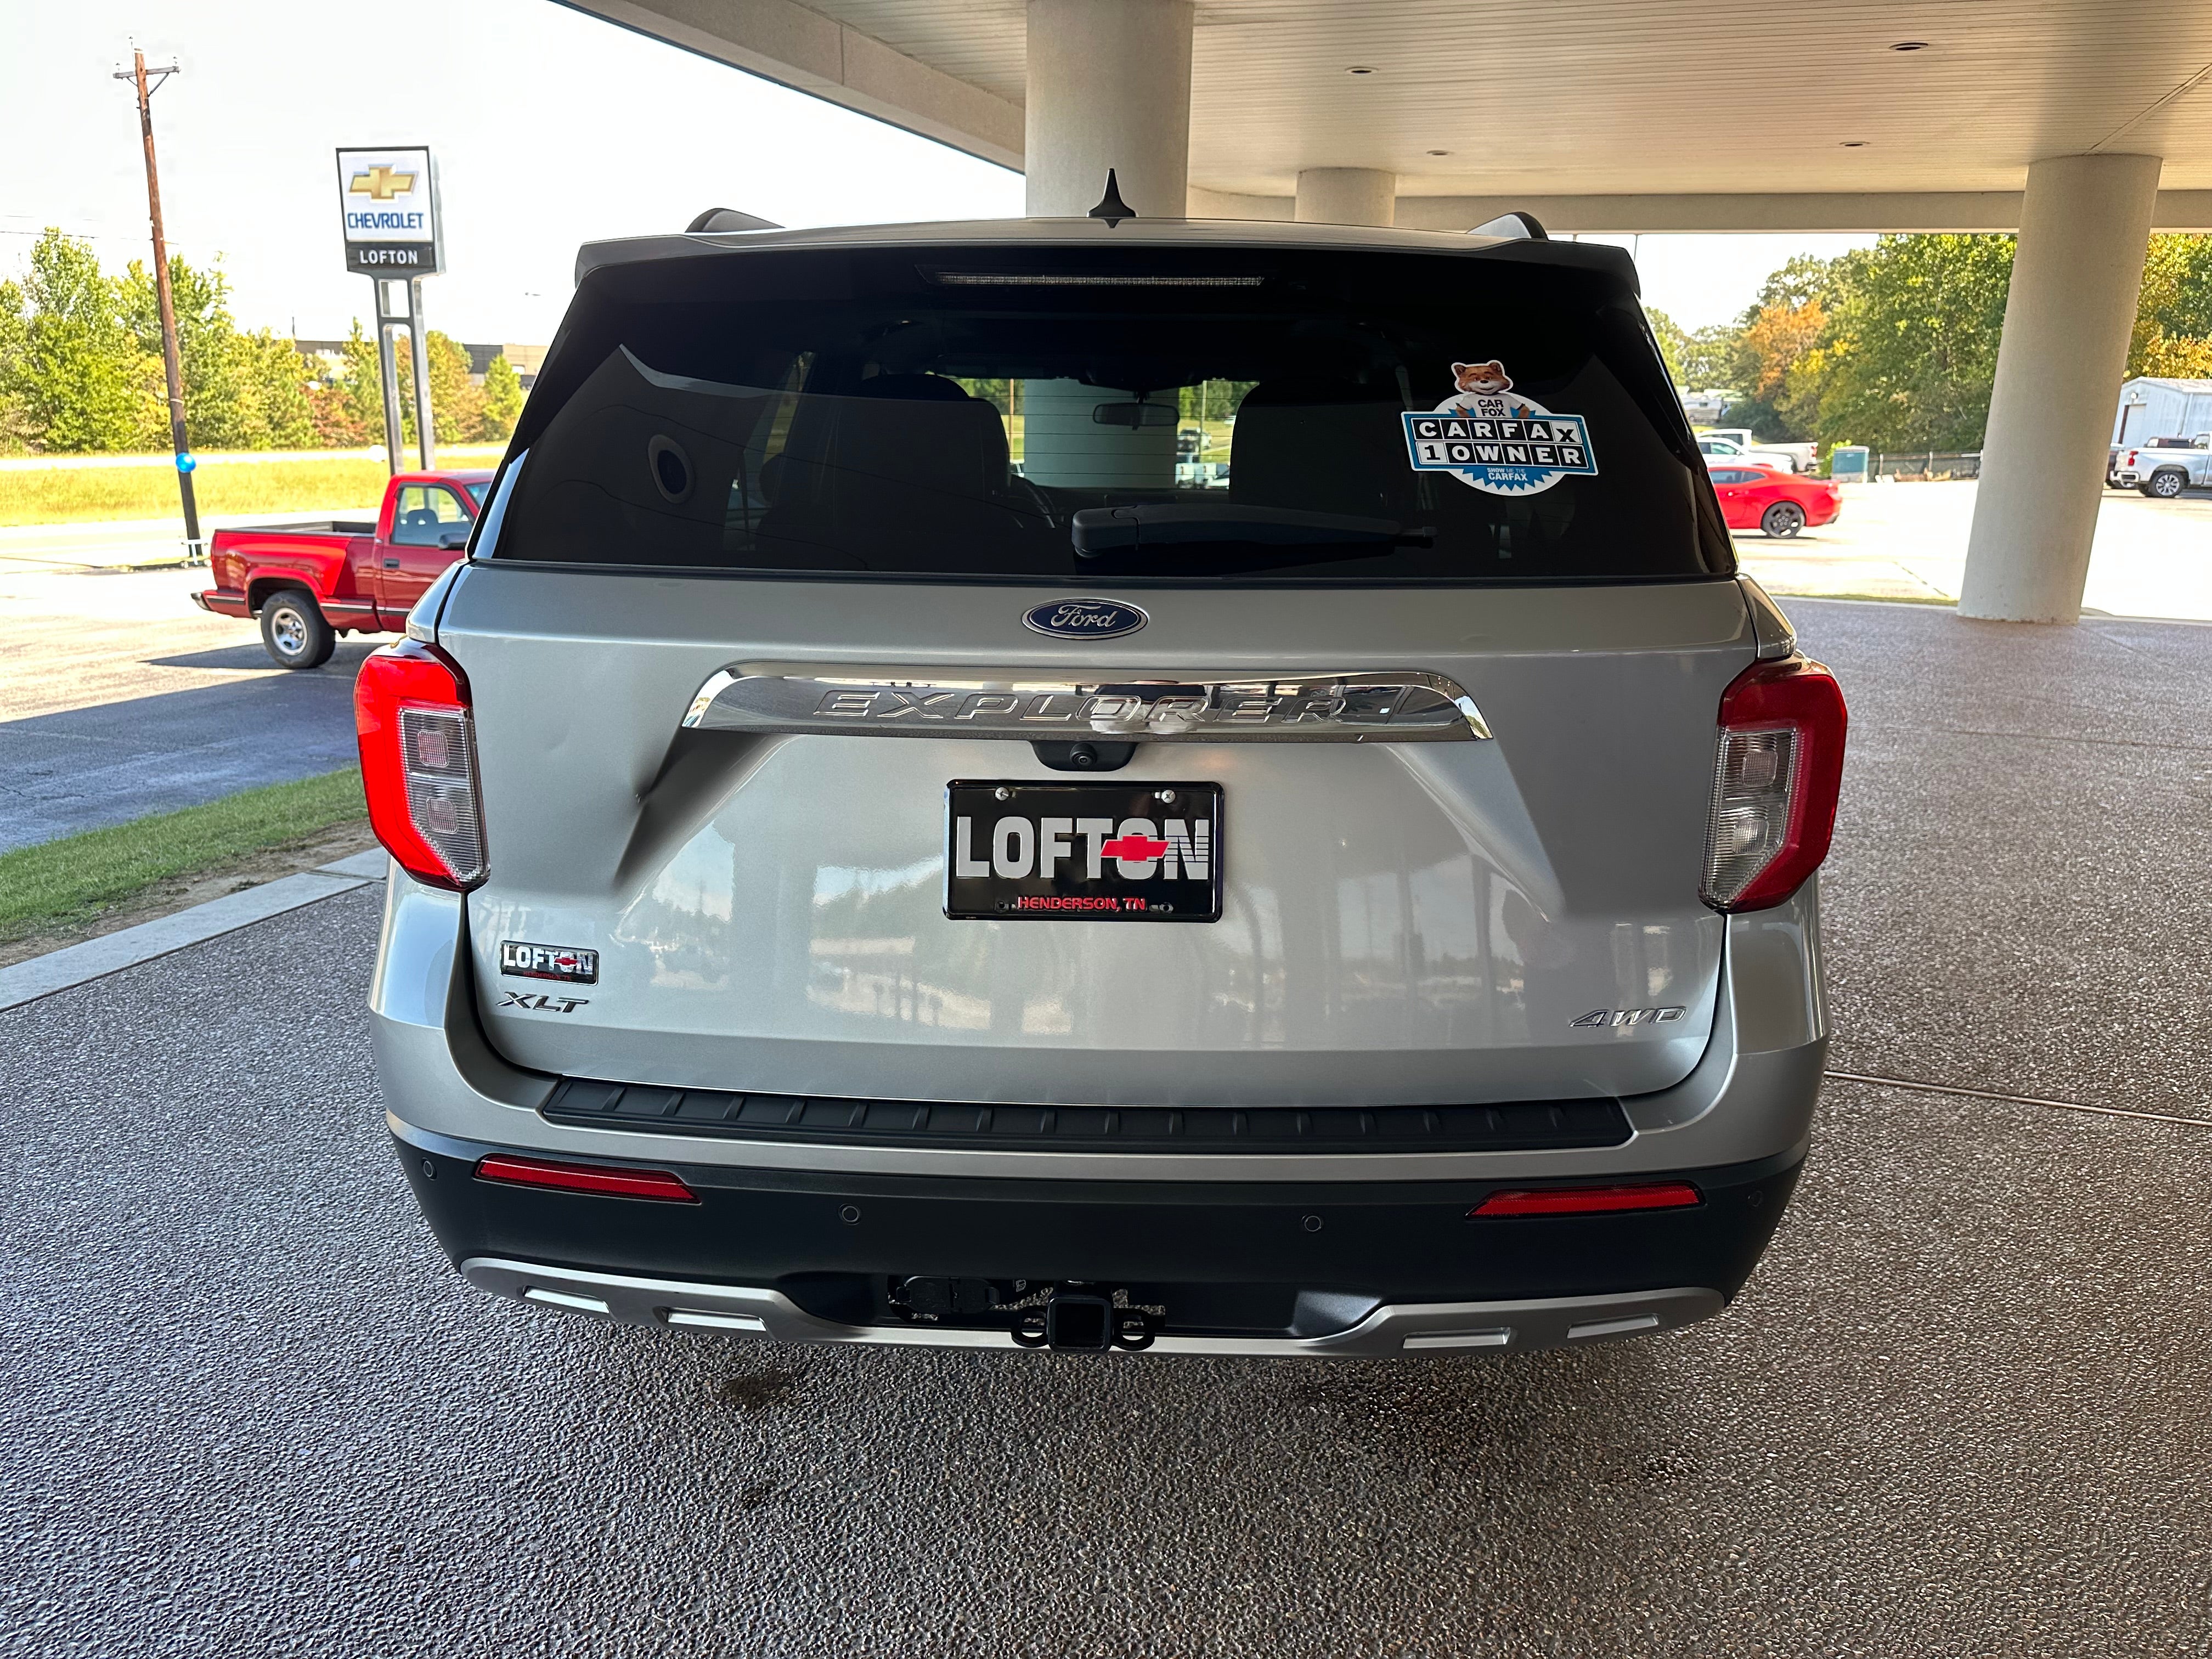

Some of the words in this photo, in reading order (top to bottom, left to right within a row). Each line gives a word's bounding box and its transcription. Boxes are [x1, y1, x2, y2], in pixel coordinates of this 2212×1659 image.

[347, 212, 424, 229] CHEVROLET
[359, 250, 419, 264] LOFTON
[1477, 399, 1504, 408] CAR
[1481, 408, 1506, 417] FOX
[1419, 421, 1577, 442] CARFAX
[1488, 472, 1528, 481] CARFAX
[1051, 605, 1119, 628] Ford
[813, 689, 1347, 723] EXPLORER
[956, 816, 1209, 881] LOFTON
[1017, 896, 1122, 912] HENDERSON,
[1123, 898, 1146, 911] TN
[503, 944, 593, 975] LOFTON
[496, 991, 590, 1013] XLT
[1568, 1006, 1688, 1028] 4WD
